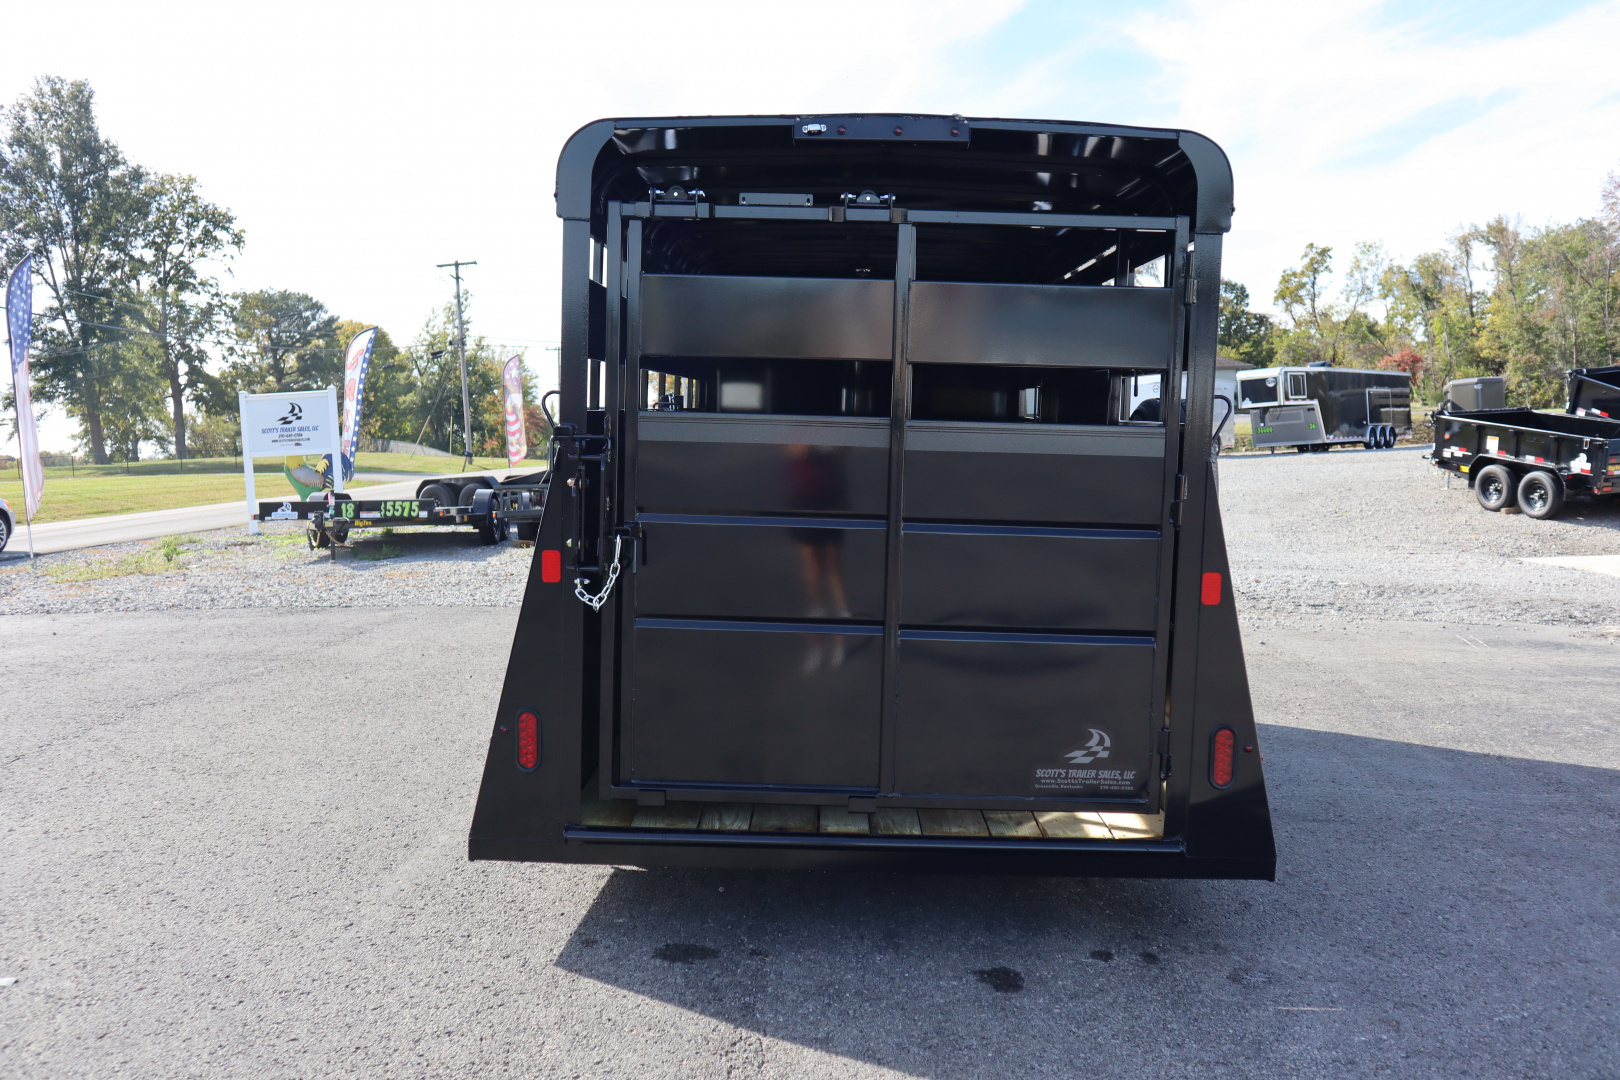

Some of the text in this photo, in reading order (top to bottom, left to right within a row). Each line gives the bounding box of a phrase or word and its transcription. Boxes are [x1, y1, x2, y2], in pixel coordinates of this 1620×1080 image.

[341, 502, 355, 518] 18
[381, 501, 420, 517] $5575
[1036, 769, 1136, 780] SCOTT'S TRAILER SALES, LLC
